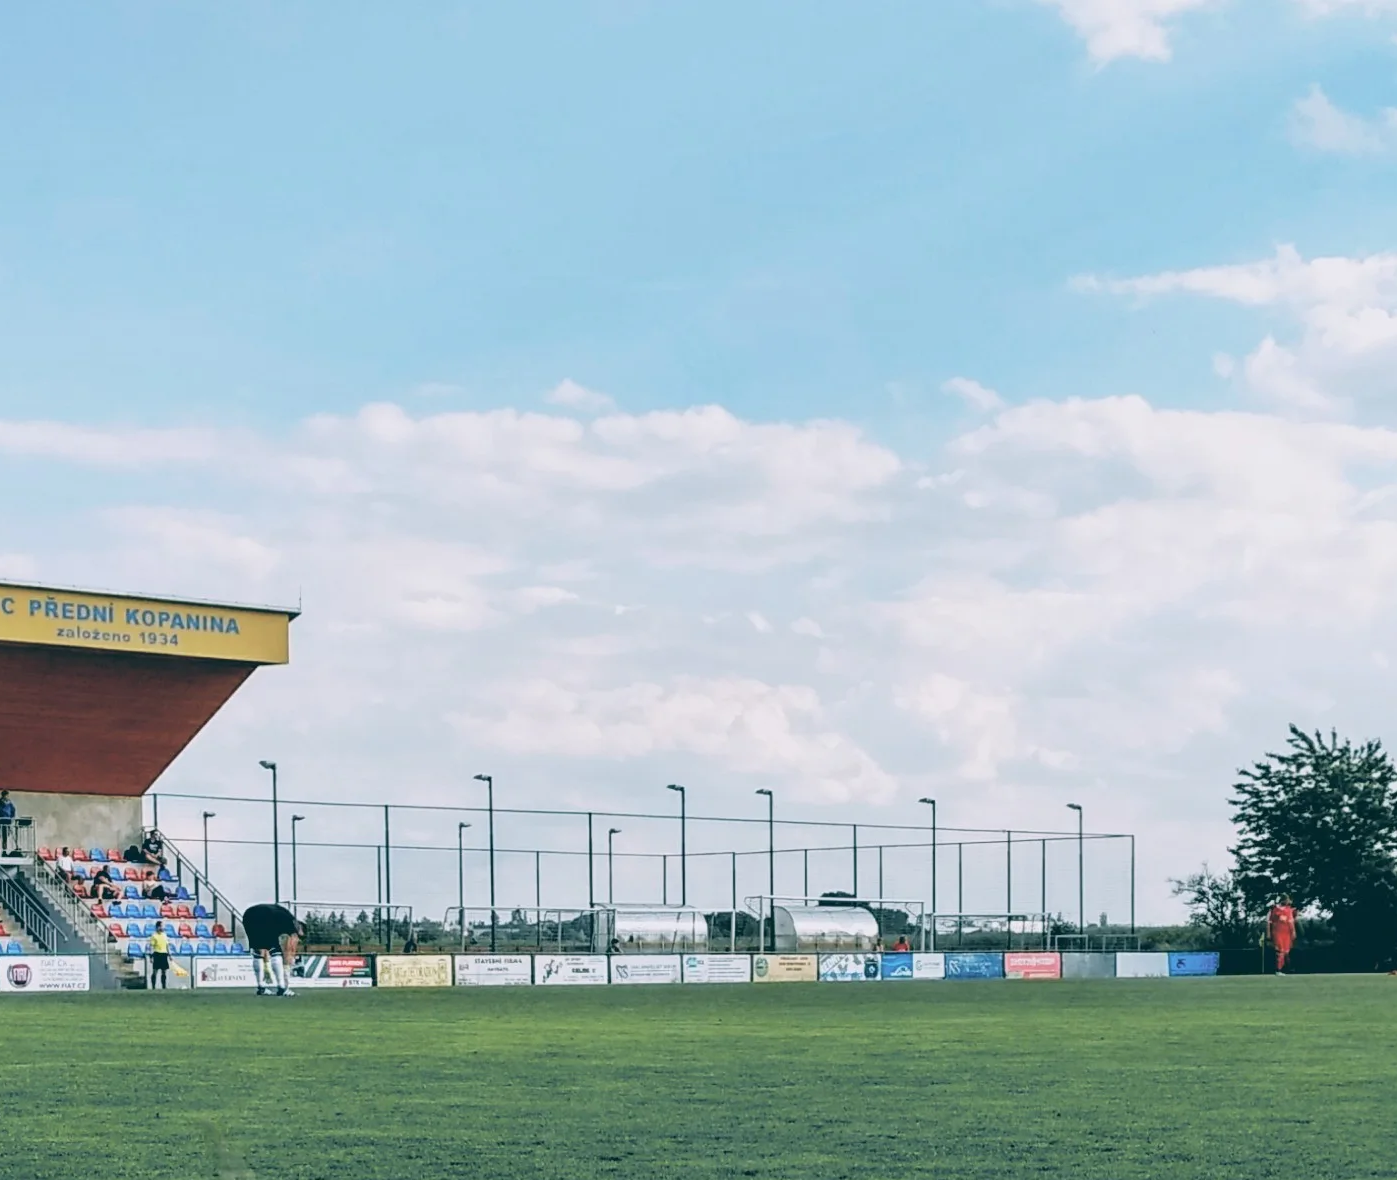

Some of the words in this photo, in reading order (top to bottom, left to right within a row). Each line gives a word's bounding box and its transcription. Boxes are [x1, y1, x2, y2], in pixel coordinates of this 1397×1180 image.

[29, 596, 114, 624] PŘEDNÍ
[125, 607, 240, 634] KOPANINA
[57, 626, 131, 643] založeno
[139, 631, 179, 647] 1934
